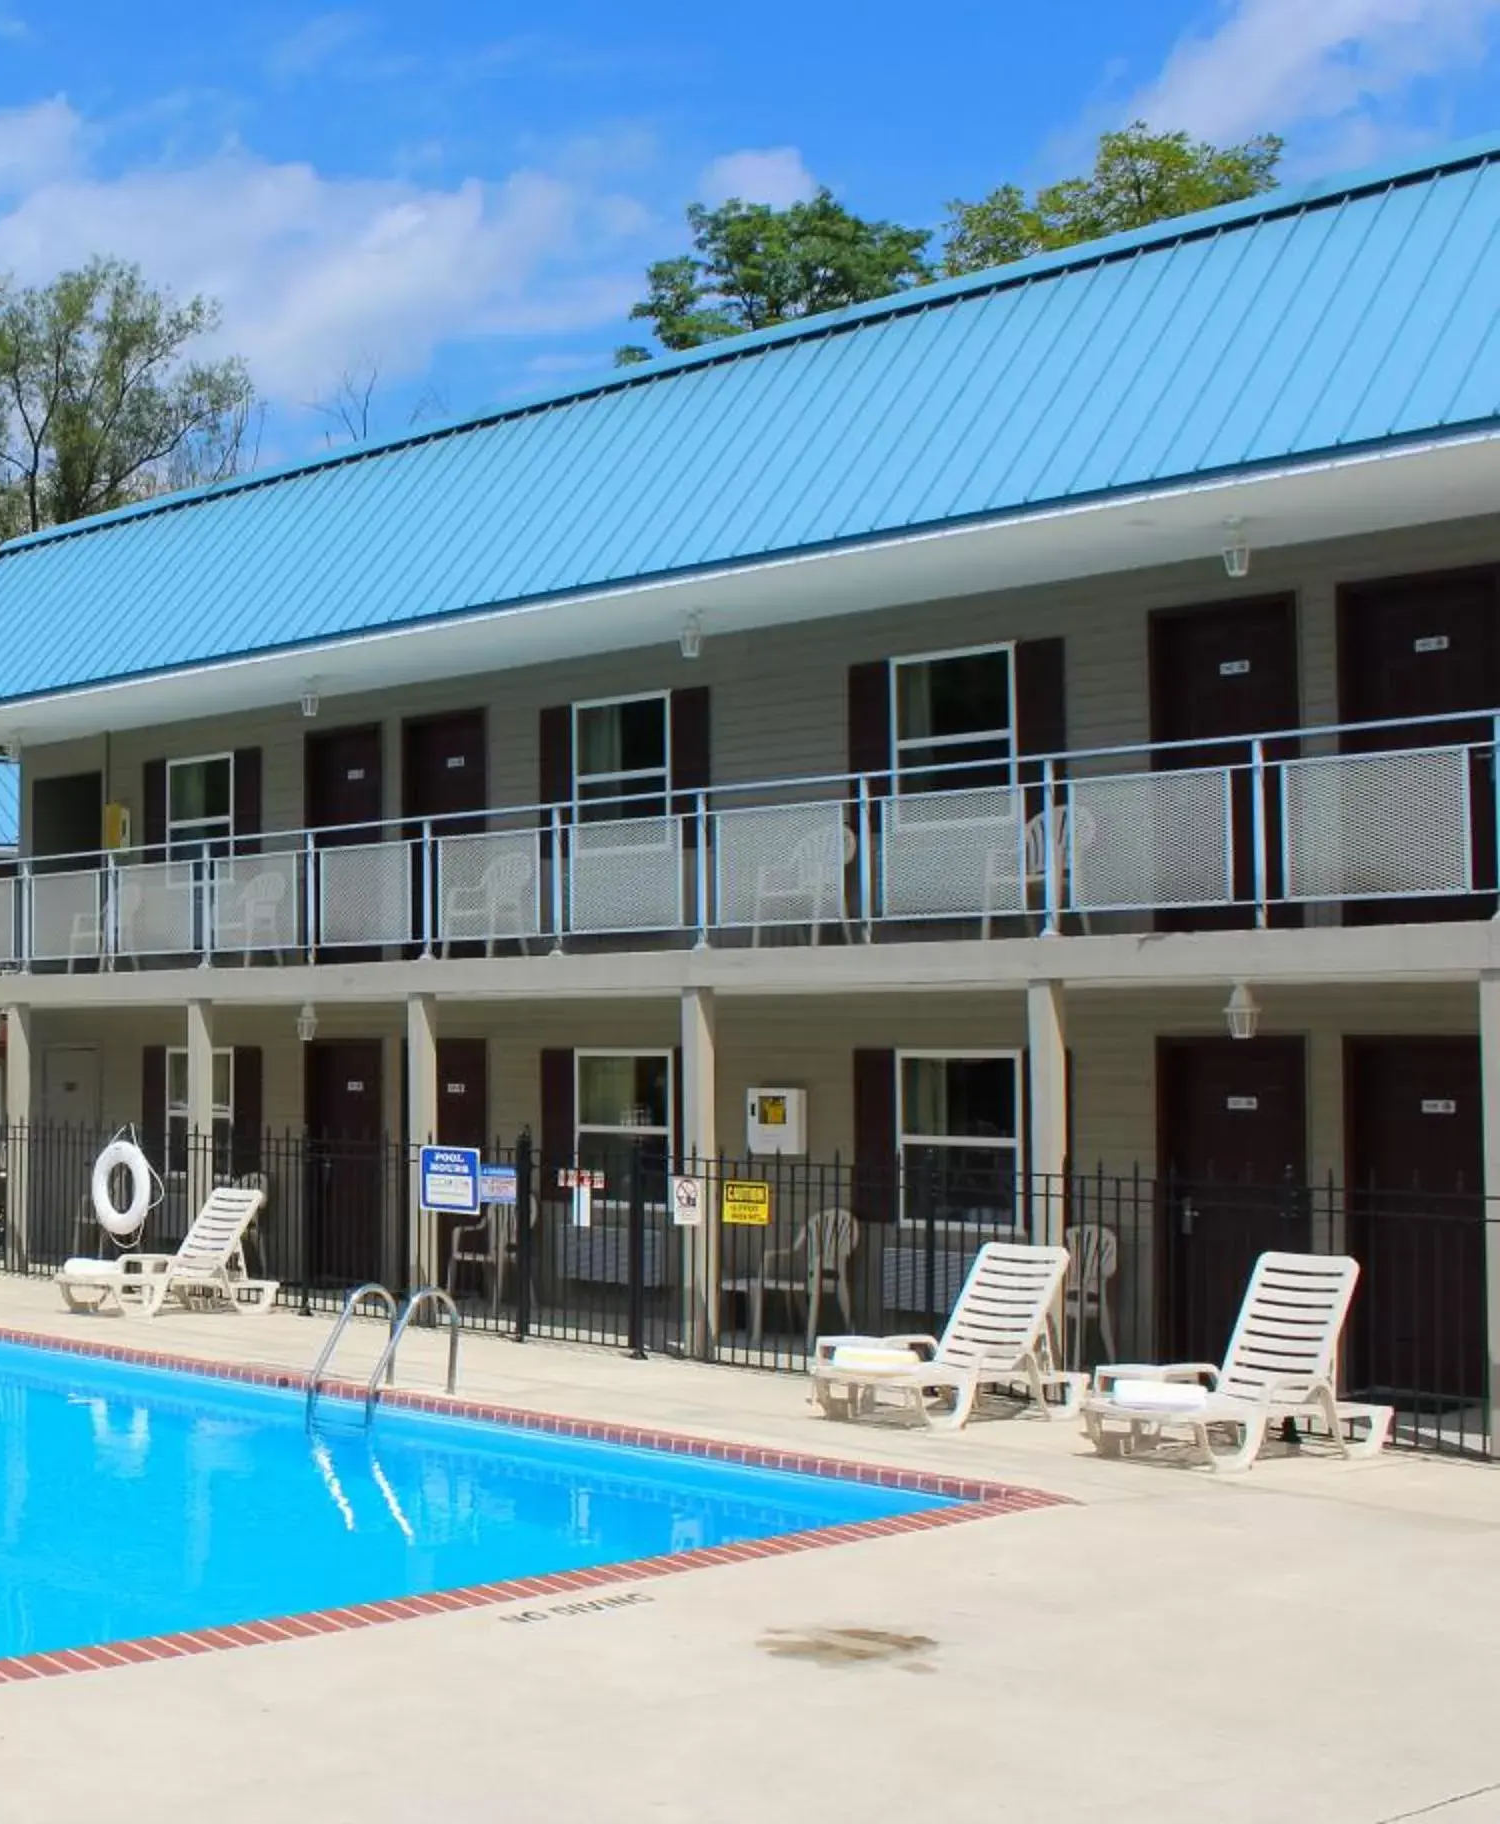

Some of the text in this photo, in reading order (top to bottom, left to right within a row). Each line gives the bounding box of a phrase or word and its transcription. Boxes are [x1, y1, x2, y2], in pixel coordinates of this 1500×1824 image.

[434, 1152, 465, 1163] POOL
[499, 1592, 656, 1624] NO DIVING
